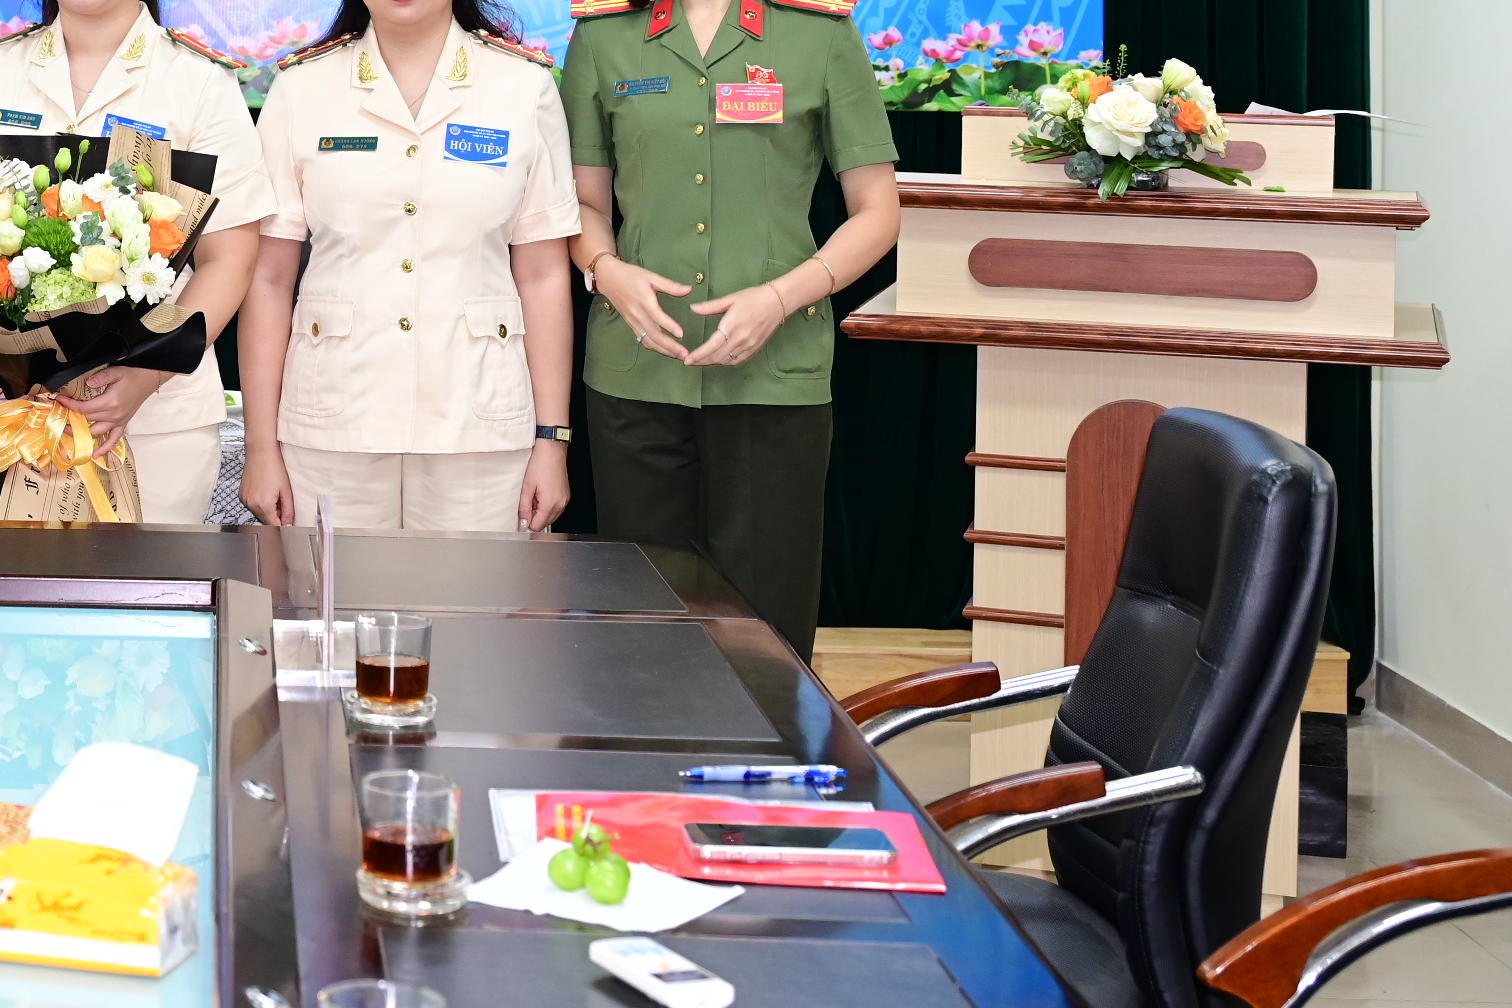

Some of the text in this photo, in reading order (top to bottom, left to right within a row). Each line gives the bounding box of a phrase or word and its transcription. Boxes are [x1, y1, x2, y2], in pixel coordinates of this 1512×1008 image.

[722, 97, 778, 112] ĐẠI BIỂU
[450, 138, 505, 156] HỘI VIÊN
